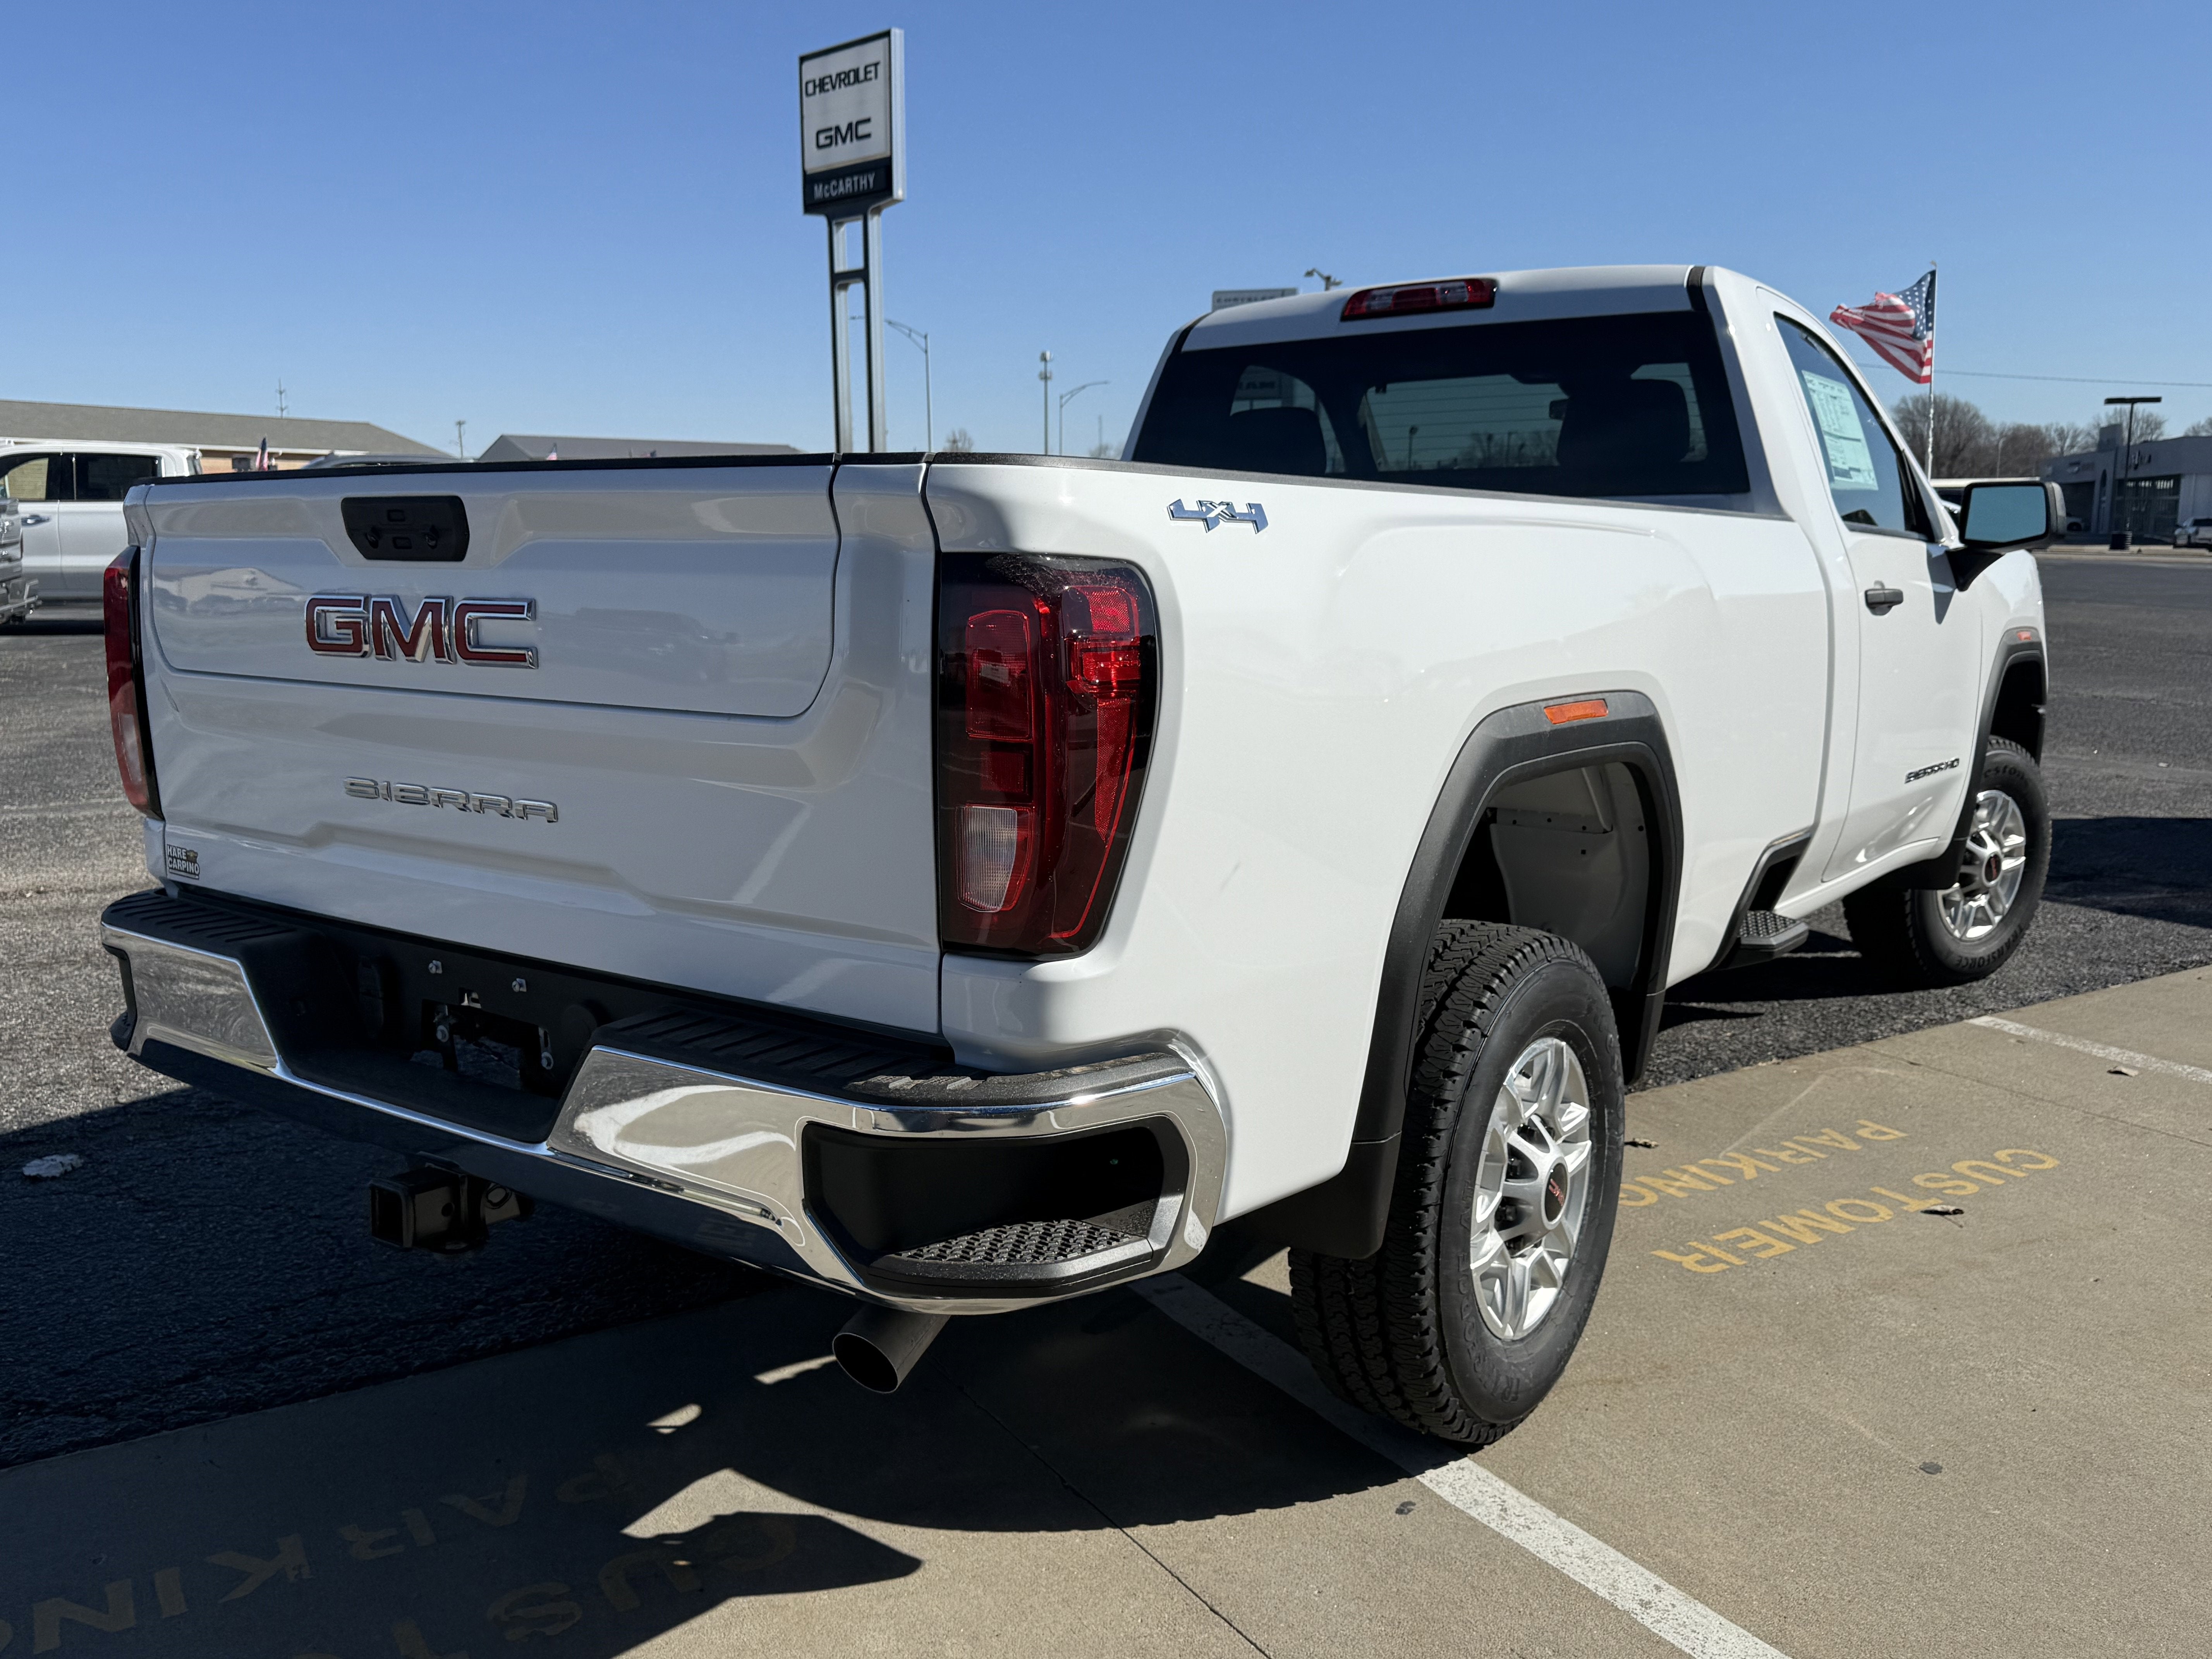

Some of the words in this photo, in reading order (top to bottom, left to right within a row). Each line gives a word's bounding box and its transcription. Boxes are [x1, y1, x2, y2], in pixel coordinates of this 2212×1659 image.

[805, 61, 881, 98] CHEVROLET
[816, 118, 872, 149] GMC
[814, 172, 876, 200] McCARTHY
[304, 593, 539, 669] GMC
[344, 776, 558, 823] SIERRA
[1618, 1119, 1910, 1207] PARKING
[1650, 1148, 2060, 1274] CUSTOMER
[0, 1452, 638, 1655] PARKIN
